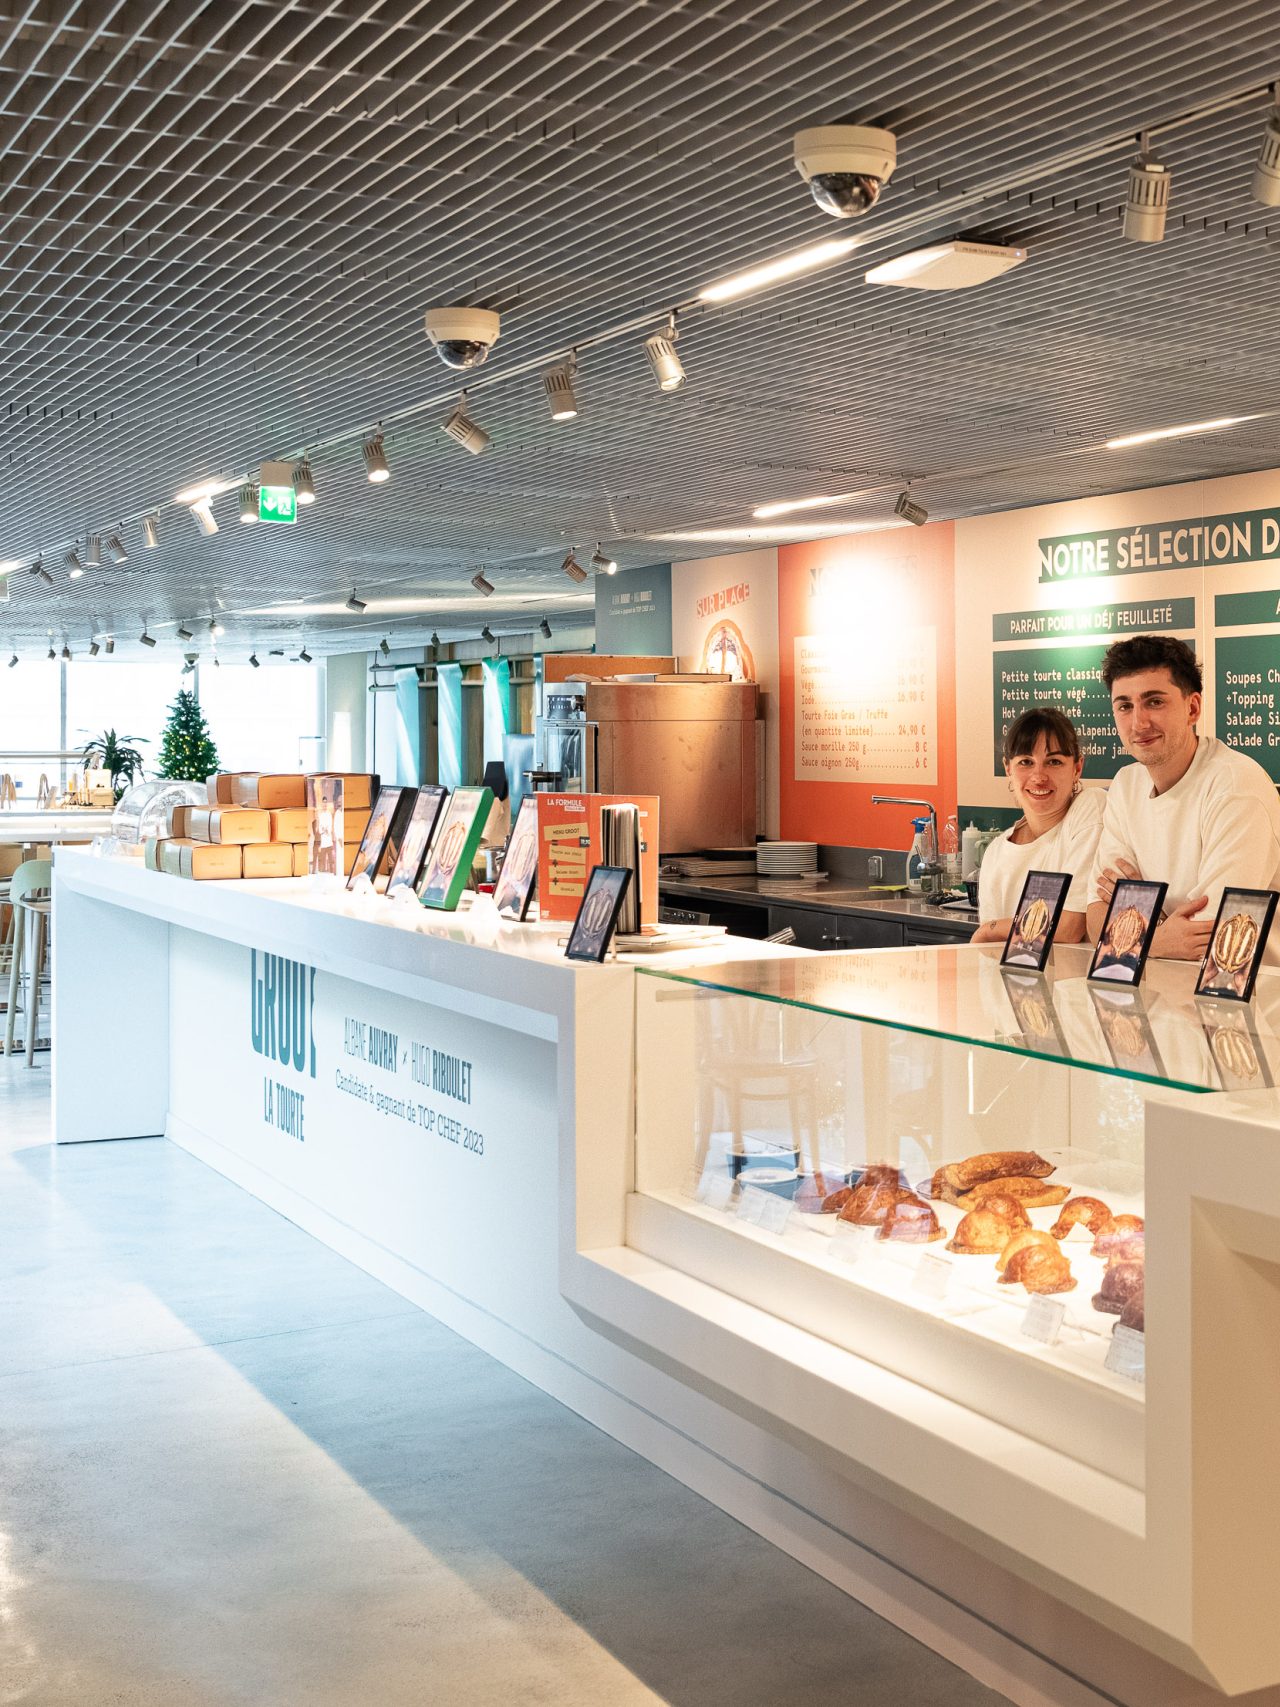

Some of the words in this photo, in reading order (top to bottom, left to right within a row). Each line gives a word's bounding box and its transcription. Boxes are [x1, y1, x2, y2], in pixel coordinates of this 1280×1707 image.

[1039, 537, 1109, 578] NOTRE
[1117, 520, 1251, 569] SÉLECTION
[697, 595, 715, 618] SUR
[719, 583, 750, 610] PLACE
[1011, 617, 1044, 633] PARFAIT
[1048, 616, 1074, 631] POUR
[1117, 605, 1172, 625] FEUILLETÉ
[1002, 671, 1029, 683] Petite
[1033, 669, 1061, 681] tourte
[1067, 668, 1104, 683] classiq
[1226, 671, 1262, 688] Soupes
[1002, 689, 1029, 701] Petite
[1034, 688, 1062, 699] tourte
[1067, 687, 1086, 703] végé
[802, 711, 821, 720] Tourte
[824, 711, 837, 719] Foie
[841, 710, 855, 719] Gras
[867, 709, 888, 719] Truffe
[1002, 707, 1015, 718] Hot
[1226, 712, 1262, 726] Salade
[802, 742, 818, 751] Sauce
[821, 742, 845, 751] morille
[1226, 733, 1262, 747] Salade
[802, 757, 818, 767] Sauce
[821, 758, 841, 770] oignon
[556, 799, 582, 807] FORMULE
[369, 1025, 398, 1074] AUVRAY
[432, 1049, 472, 1105] RIBOULET
[264, 1076, 274, 1125] LA
[276, 1083, 304, 1142] TOURTE
[376, 1090, 406, 1121] gagnant
[407, 1100, 416, 1125] de
[418, 1104, 435, 1132] TOP
[437, 1114, 462, 1144] CHEF
[463, 1127, 484, 1156] 2023
